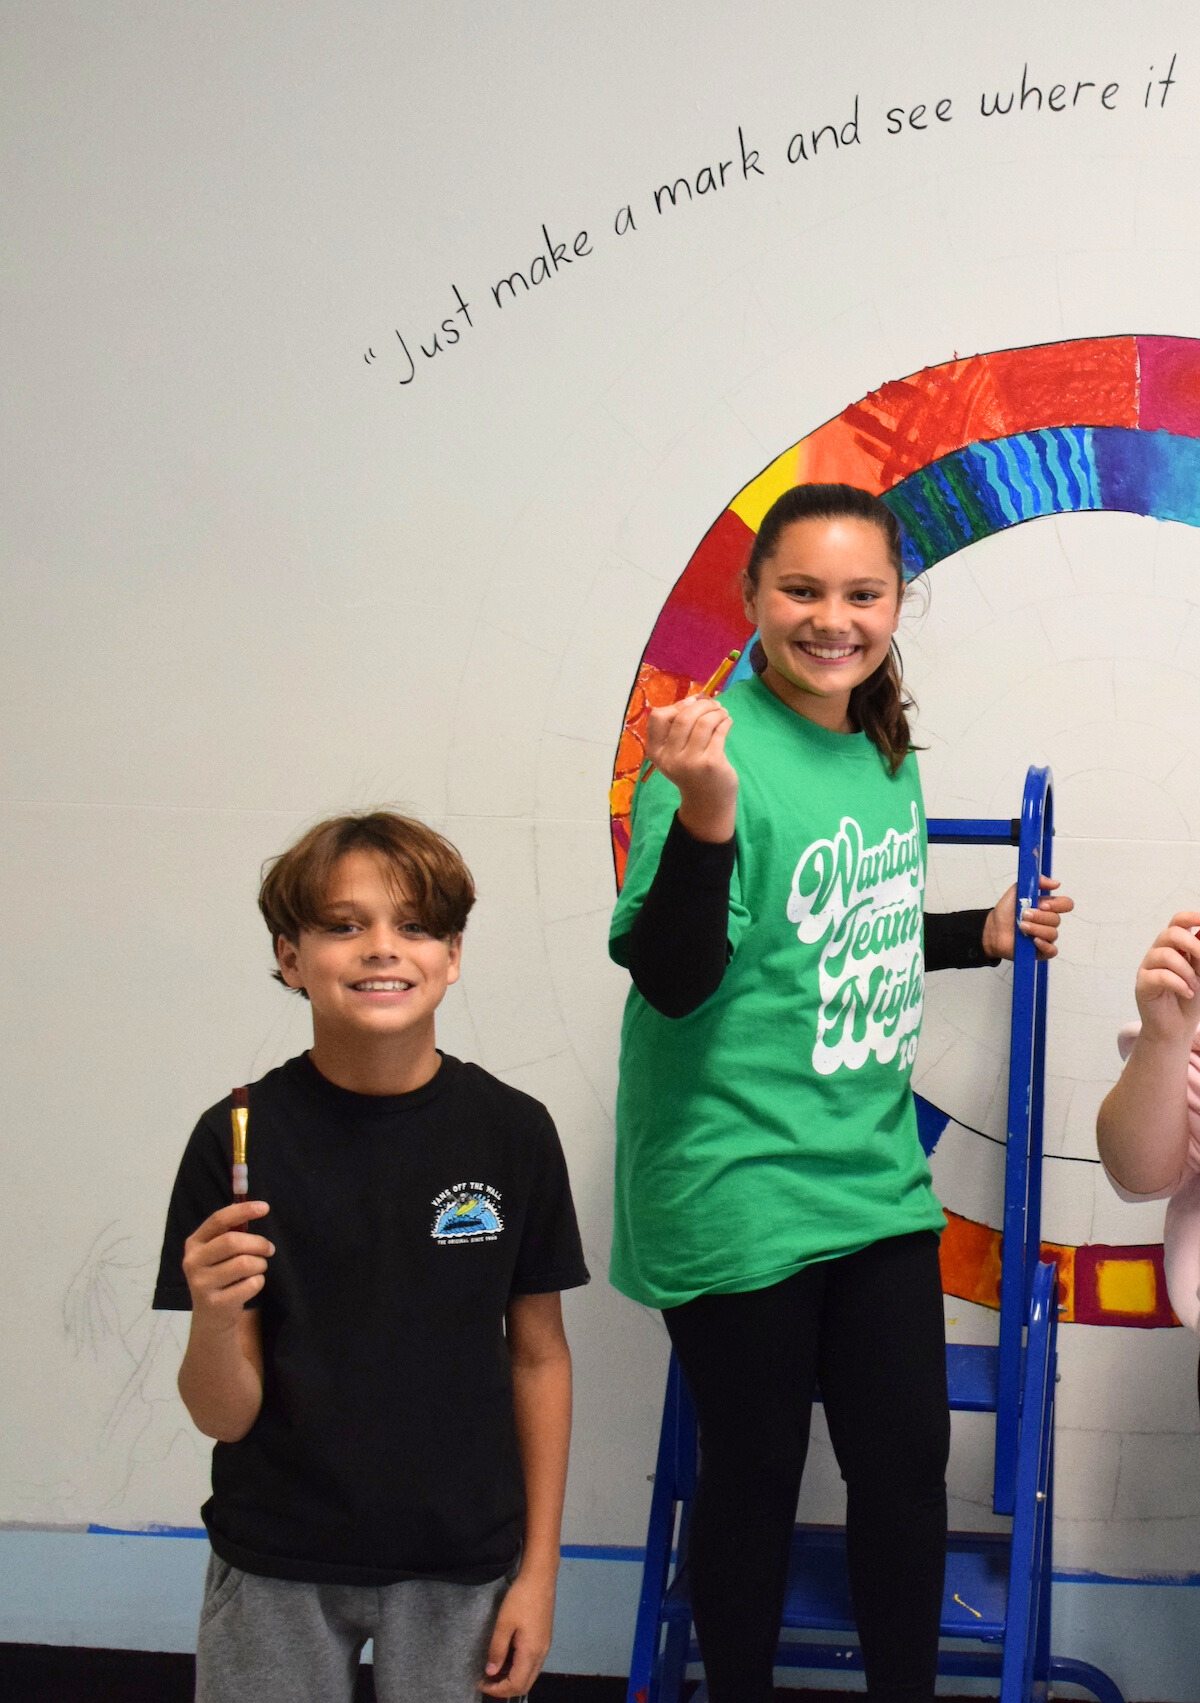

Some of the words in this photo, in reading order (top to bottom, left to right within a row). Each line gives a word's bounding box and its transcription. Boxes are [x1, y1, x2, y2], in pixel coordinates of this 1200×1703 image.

[490, 223, 594, 309] make
[614, 204, 638, 236] a
[653, 125, 765, 215] mark
[786, 94, 862, 165] and
[886, 98, 953, 135] see
[980, 62, 1120, 118] where
[1144, 52, 1177, 109] it
[798, 803, 922, 915] Wantag
[823, 896, 919, 979] Team
[822, 951, 922, 1049] Nigh
[431, 1189, 451, 1206] VANS
[452, 1182, 467, 1192] OFF
[470, 1182, 484, 1191] THE
[486, 1185, 502, 1200] WALL
